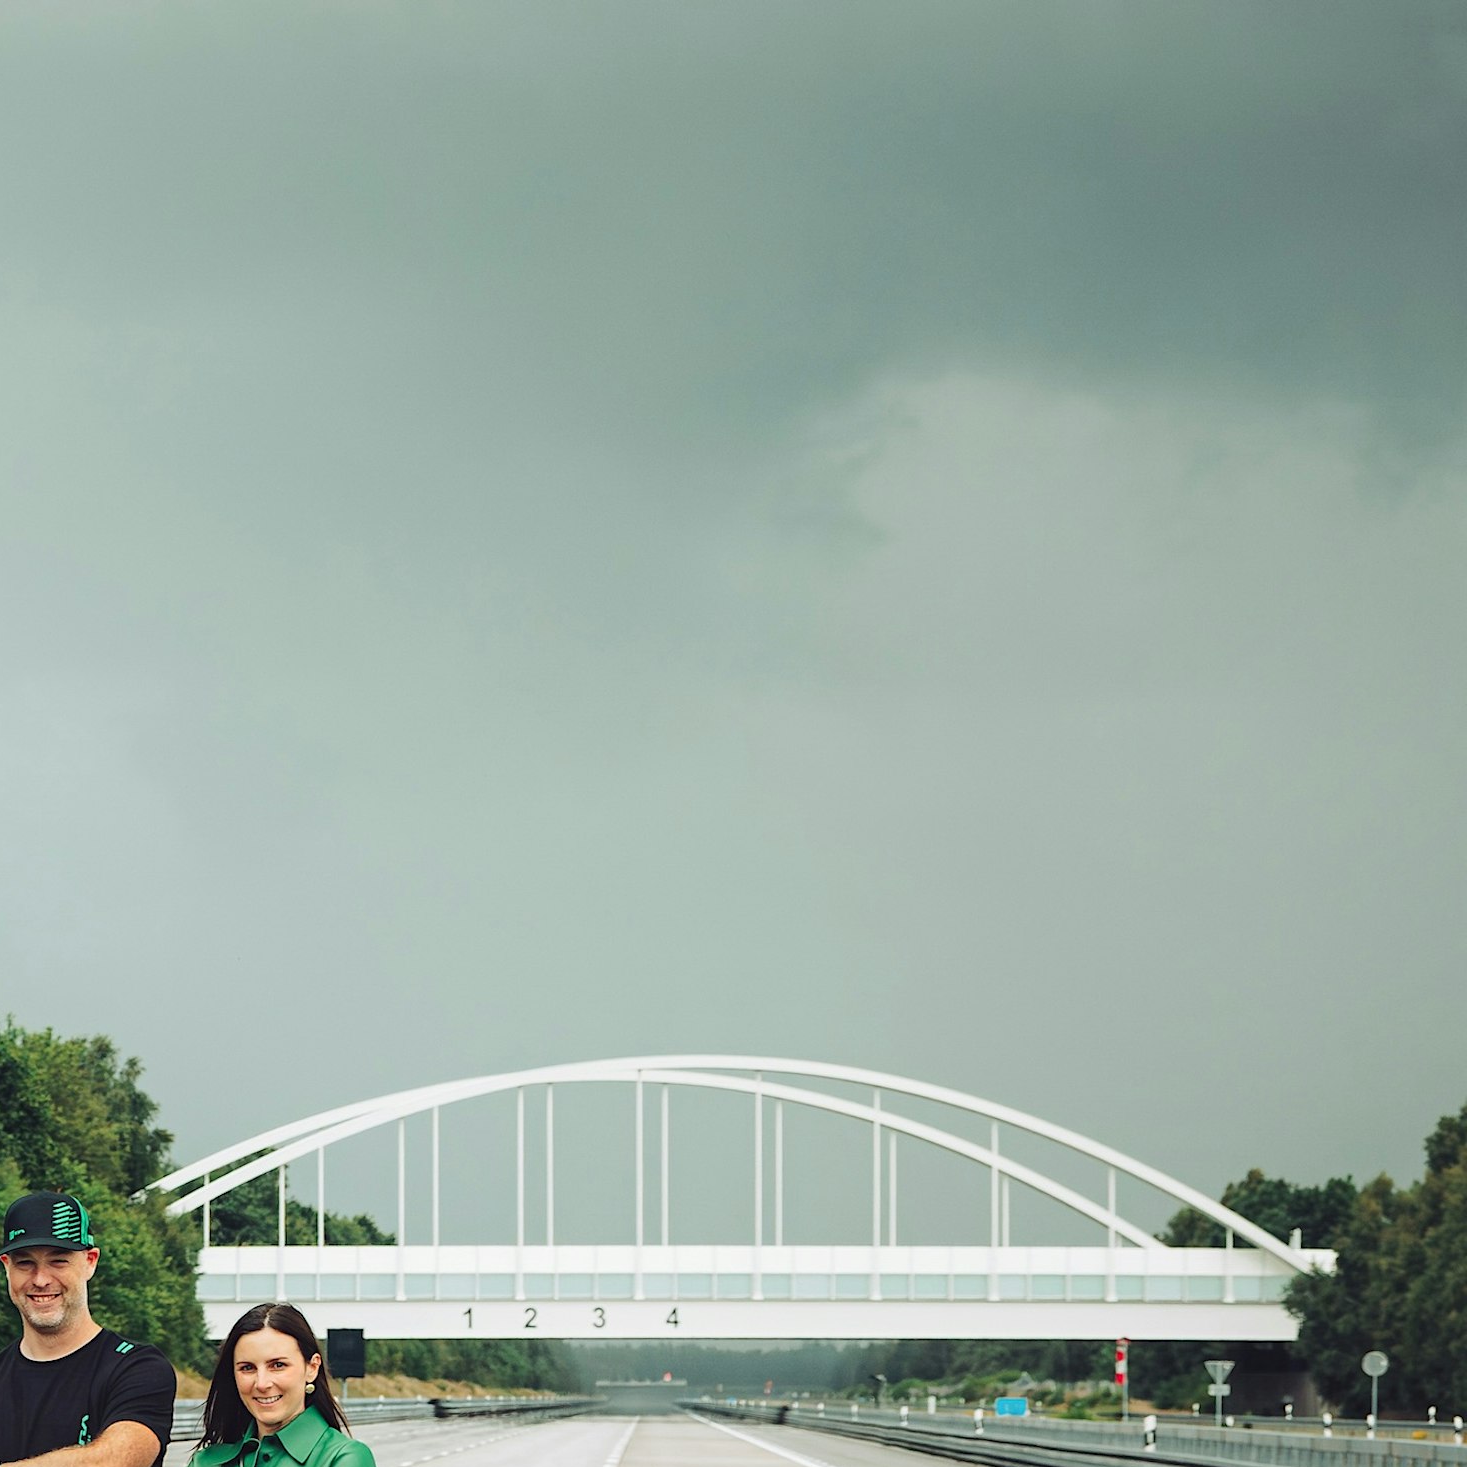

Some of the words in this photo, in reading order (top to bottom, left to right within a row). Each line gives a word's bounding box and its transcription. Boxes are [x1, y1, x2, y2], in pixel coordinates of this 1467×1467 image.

[463, 1307, 473, 1329] 1
[524, 1307, 538, 1329] 2
[592, 1307, 606, 1328] 3
[666, 1307, 680, 1328] 4
